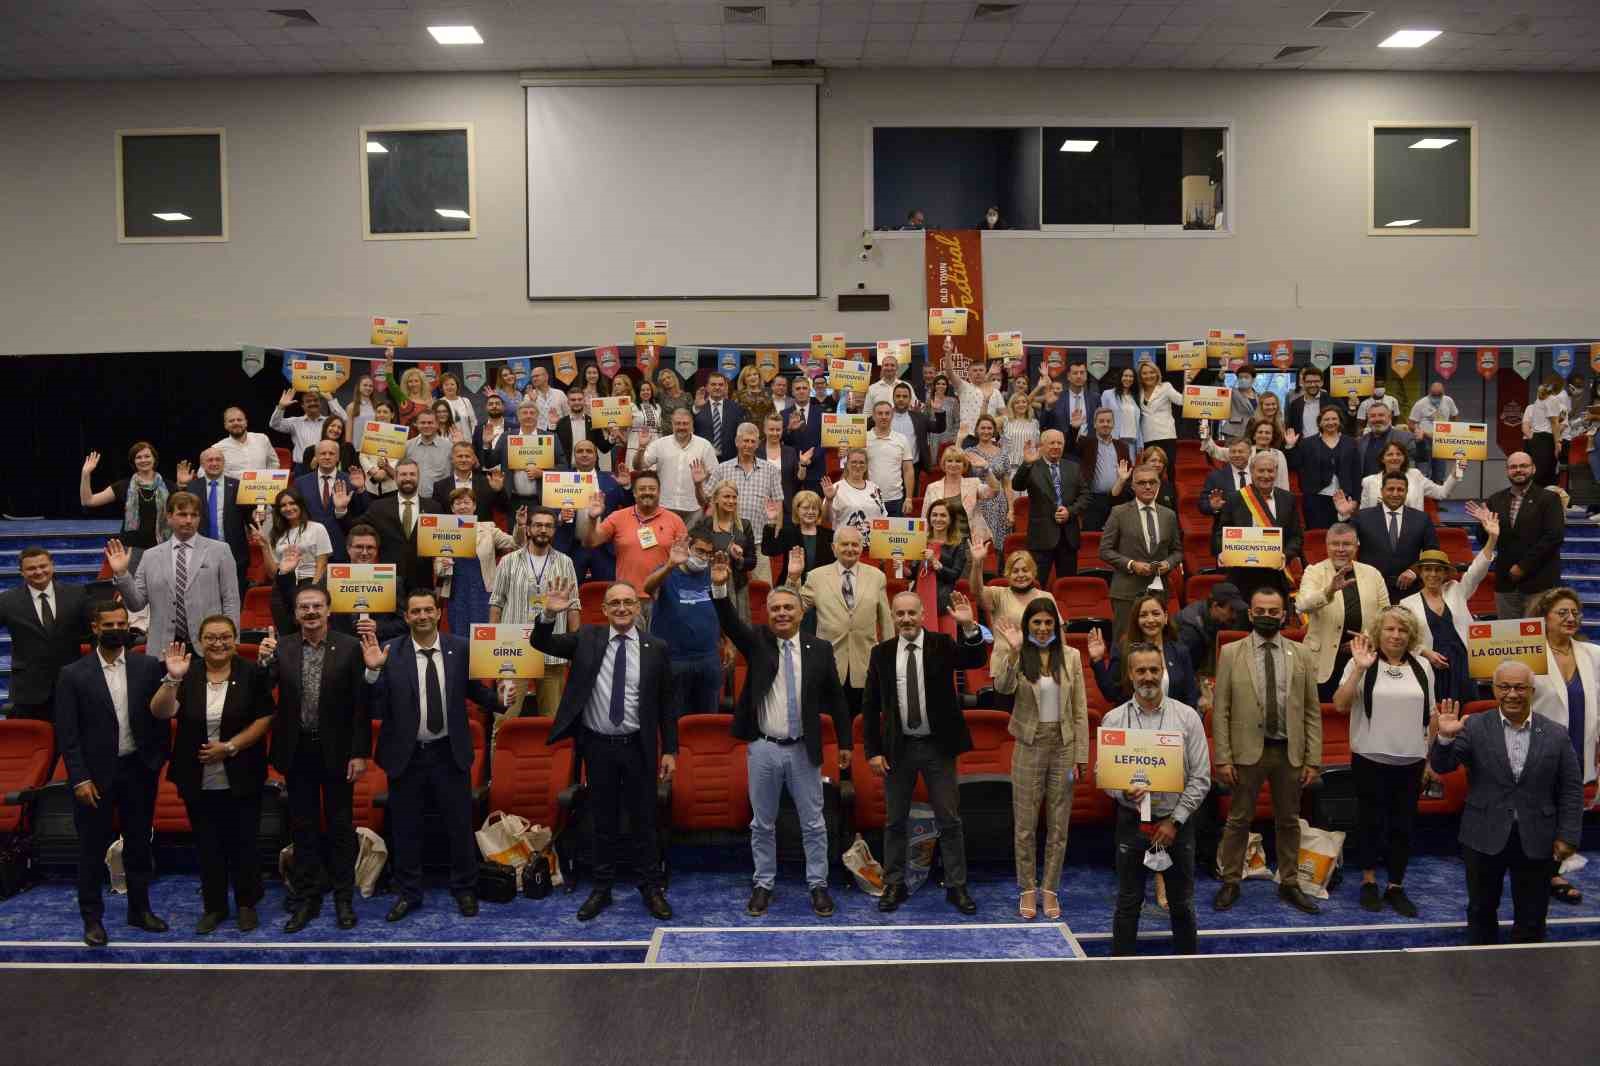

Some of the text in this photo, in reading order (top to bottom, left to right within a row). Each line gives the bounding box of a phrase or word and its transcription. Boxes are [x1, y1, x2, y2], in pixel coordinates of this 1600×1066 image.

[935, 233, 979, 320] Festival
[940, 262, 949, 303] OLD TOWN
[1189, 400, 1225, 408] POGRADEC
[1434, 438, 1486, 447] HEUSENSTAMM
[554, 487, 584, 495] KOMRAT
[888, 536, 909, 544] SIBIU
[1224, 544, 1281, 552] MUGGENSTURM
[339, 585, 385, 593] ZIGETVAR
[492, 646, 524, 656] GİRNE
[1471, 644, 1543, 657] LA GOULETTE
[1114, 754, 1167, 769] LEFKOŞA
